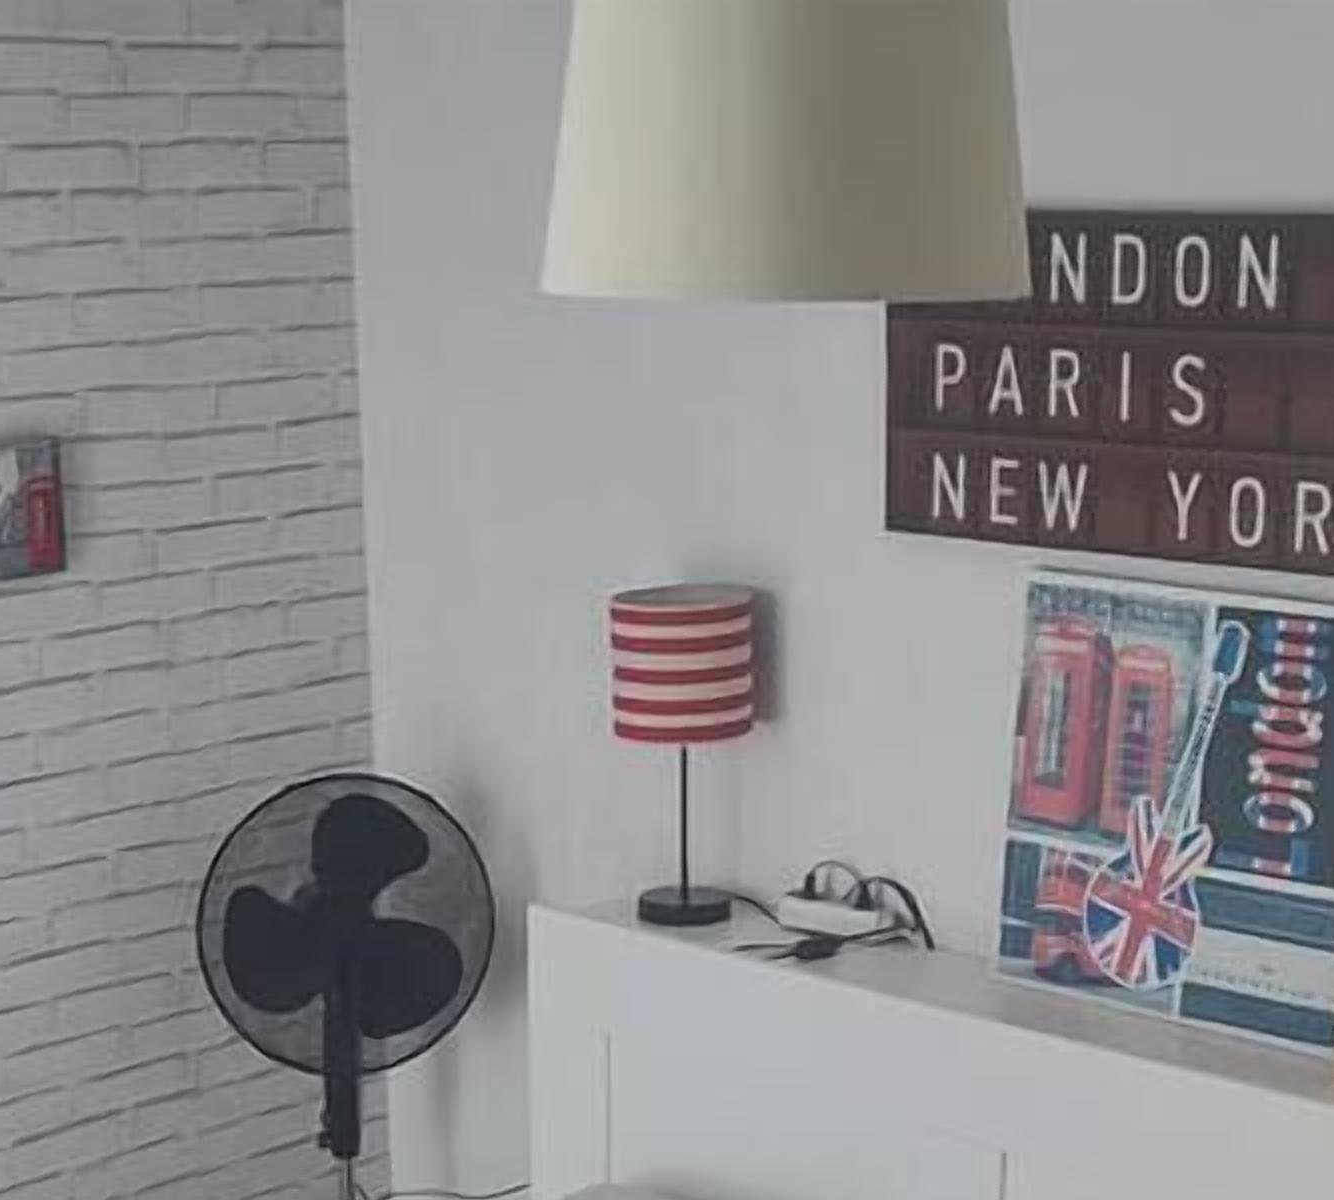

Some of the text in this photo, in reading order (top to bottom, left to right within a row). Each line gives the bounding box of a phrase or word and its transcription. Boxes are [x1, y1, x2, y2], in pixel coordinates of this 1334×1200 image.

[1048, 232, 1281, 310] NDON
[932, 343, 1209, 426] PARIS
[930, 453, 1089, 532] NEW
